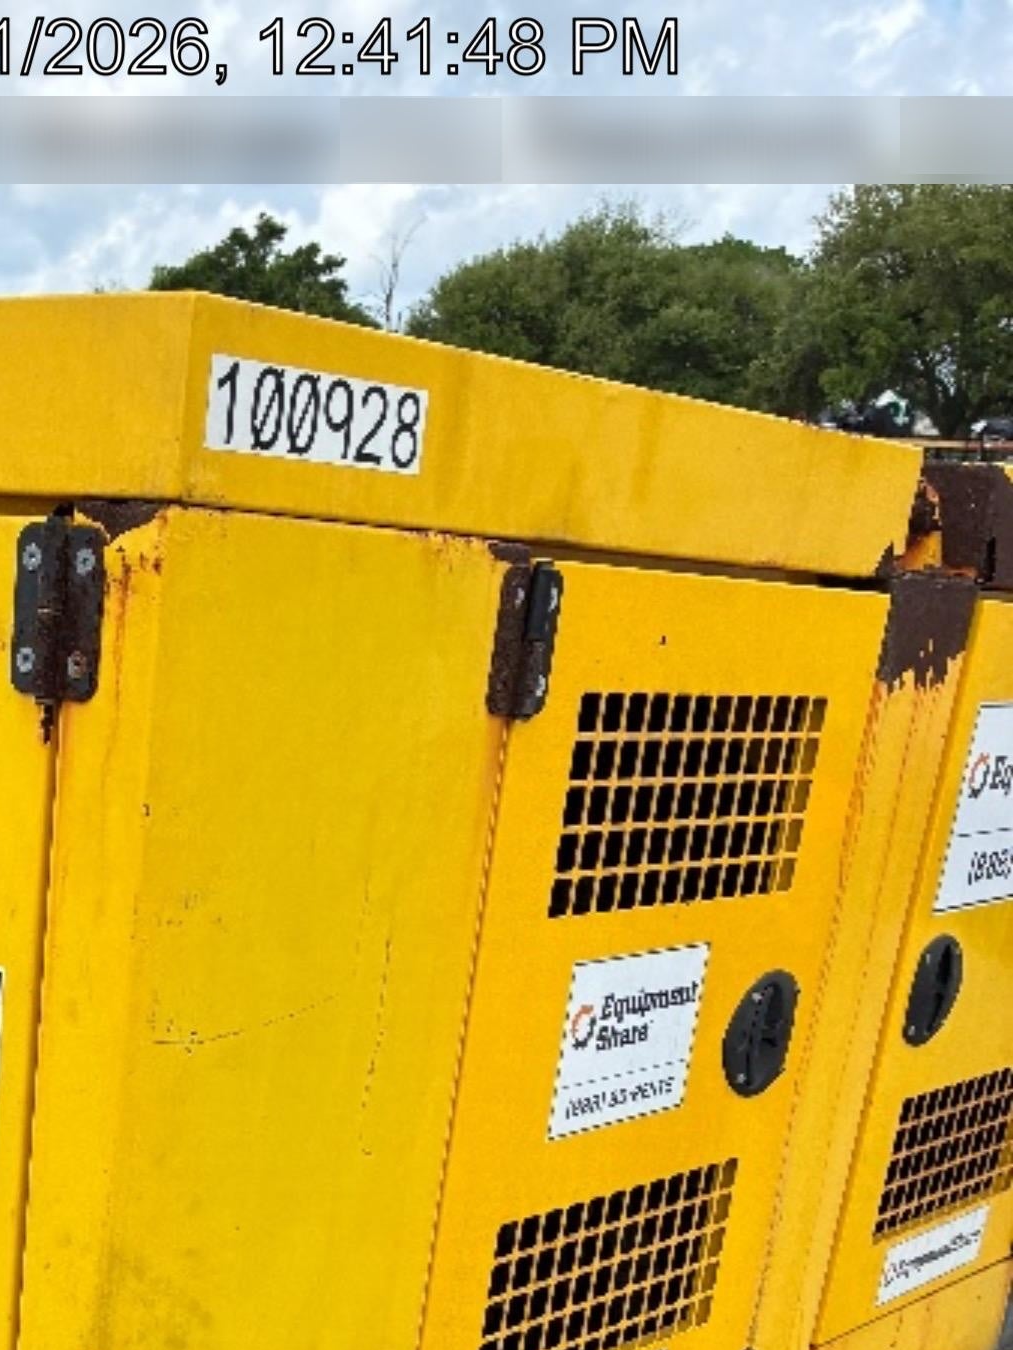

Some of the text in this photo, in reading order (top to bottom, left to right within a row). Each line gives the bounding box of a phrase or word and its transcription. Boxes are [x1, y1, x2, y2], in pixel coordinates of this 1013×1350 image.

[217, 361, 421, 469] 100928
[598, 981, 699, 1024] Equipment
[595, 1022, 649, 1051] Share
